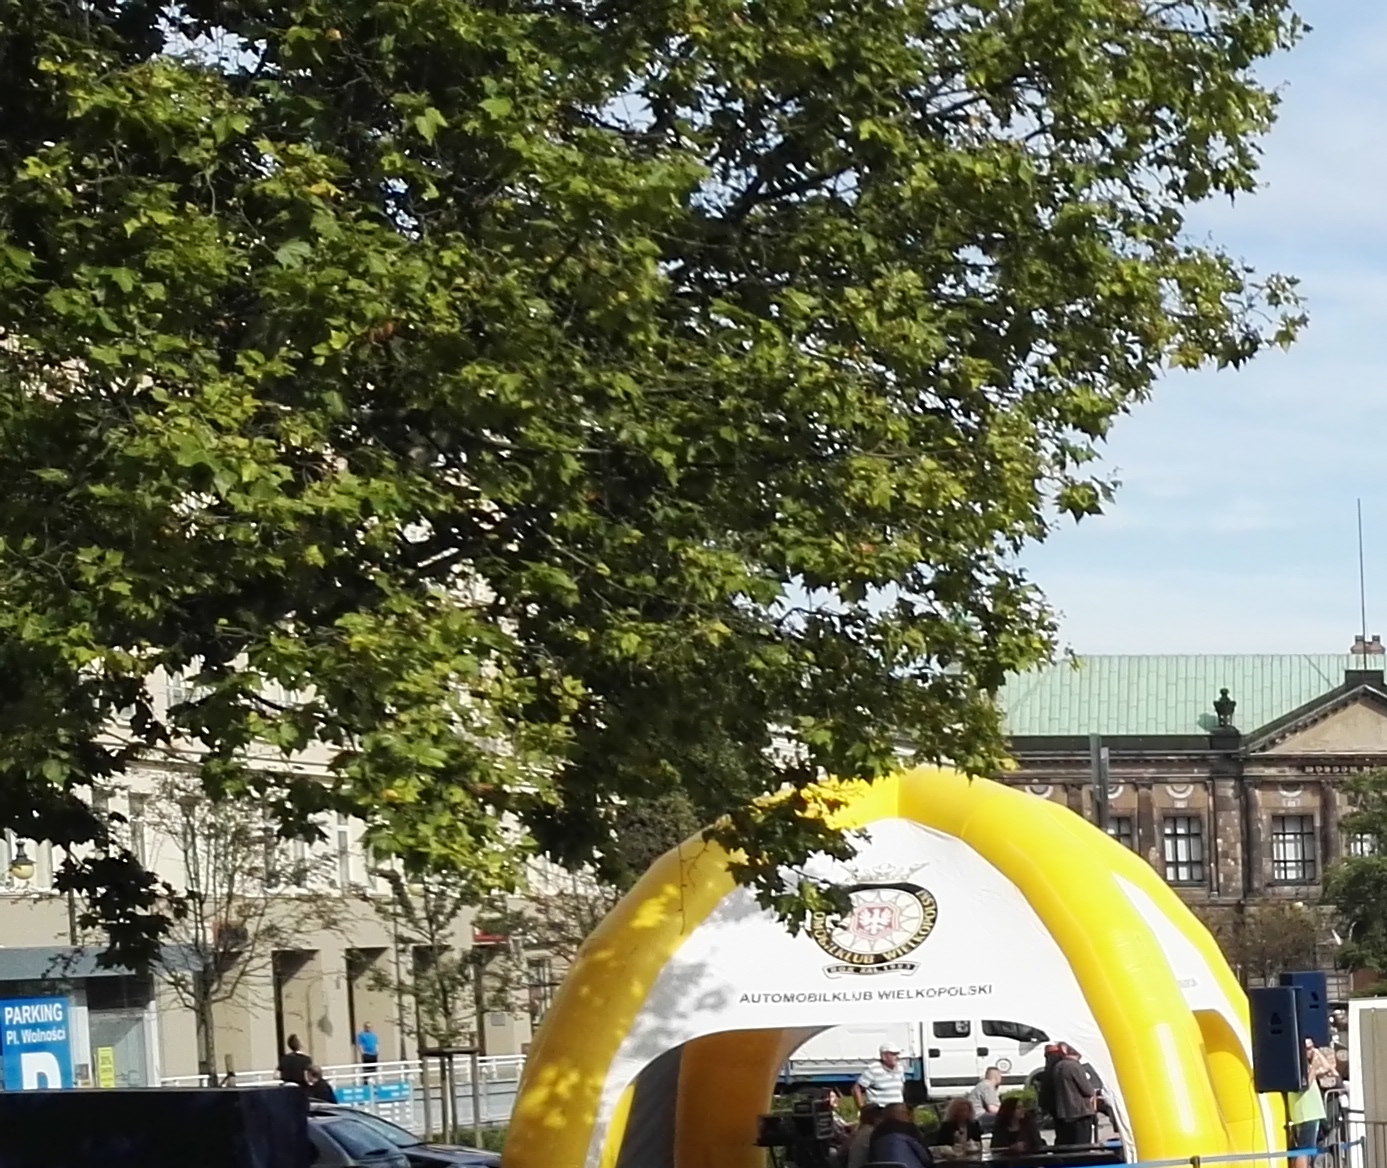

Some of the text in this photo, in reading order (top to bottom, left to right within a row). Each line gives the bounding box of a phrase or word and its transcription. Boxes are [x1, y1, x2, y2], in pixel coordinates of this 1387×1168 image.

[739, 984, 993, 1005] AUTOMOBILKLUB WIELKOPOLSKI
[4, 1003, 63, 1025] PARKING
[20, 1025, 66, 1044] Wolności
